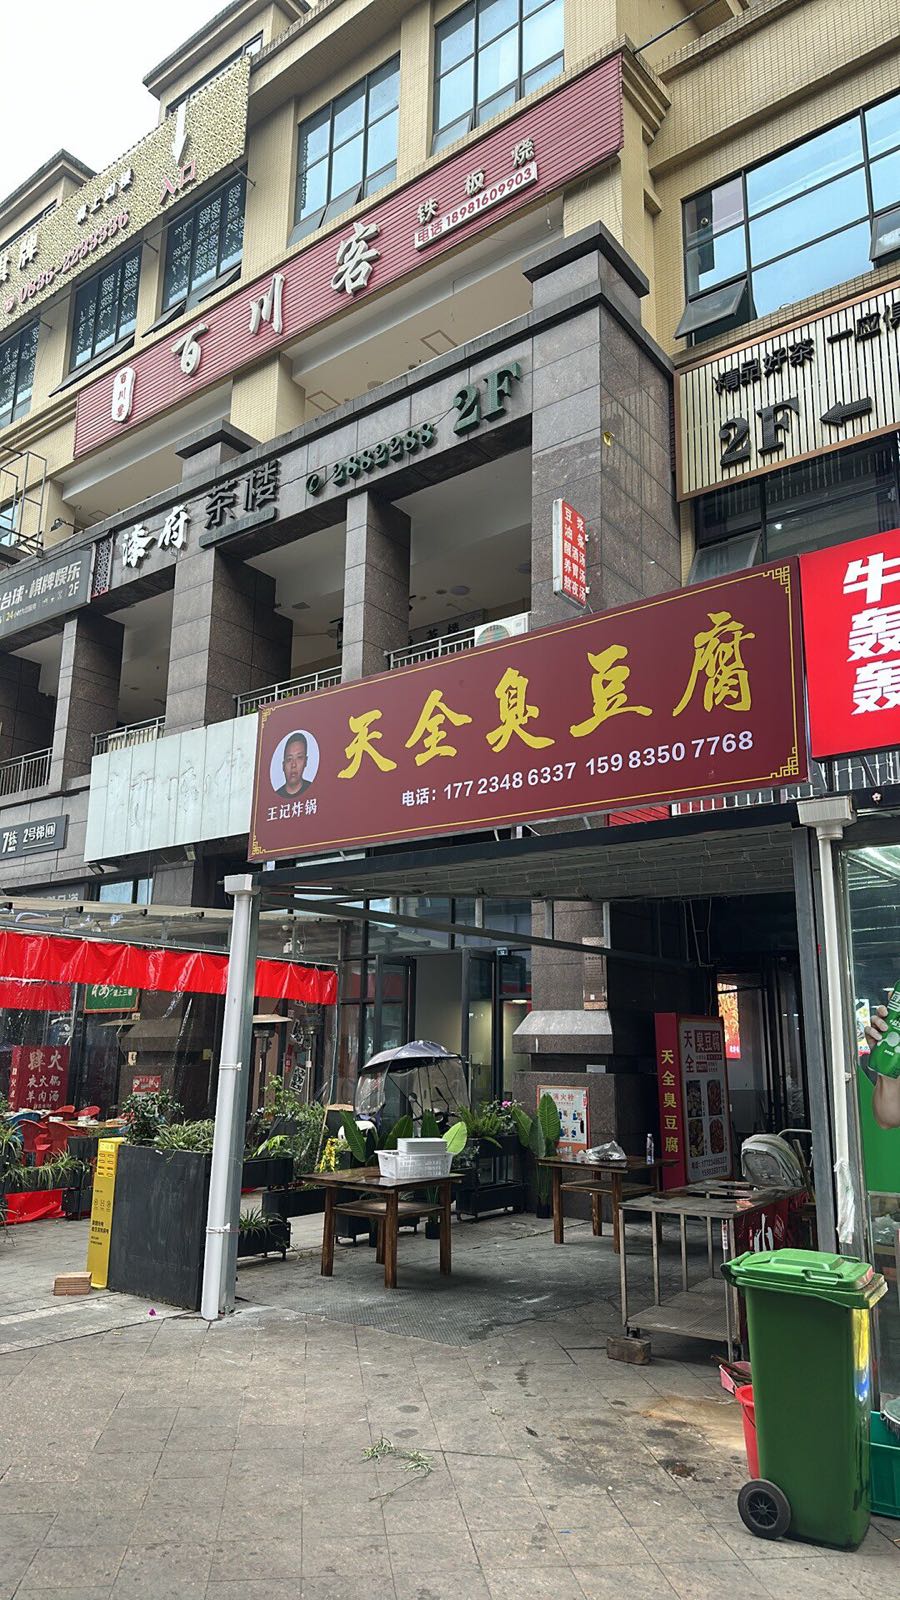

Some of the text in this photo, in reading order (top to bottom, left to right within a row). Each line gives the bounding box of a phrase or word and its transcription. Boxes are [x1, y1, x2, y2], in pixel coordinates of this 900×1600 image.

[160, 161, 196, 205] 入口
[417, 138, 535, 225] 铁板烧
[417, 167, 533, 243] 电话 18981609903
[170, 222, 381, 377] 百川客
[712, 338, 815, 394] 精品好茶
[332, 362, 521, 487] 2882288 2F
[718, 397, 800, 466] 2F
[68, 581, 80, 597] 2F
[337, 611, 756, 780] 天全臭豆腐
[266, 798, 317, 822] 王记炸锅
[684, 1030, 694, 1073] 天全
[660, 1049, 679, 1153] 天全臭豆腐
